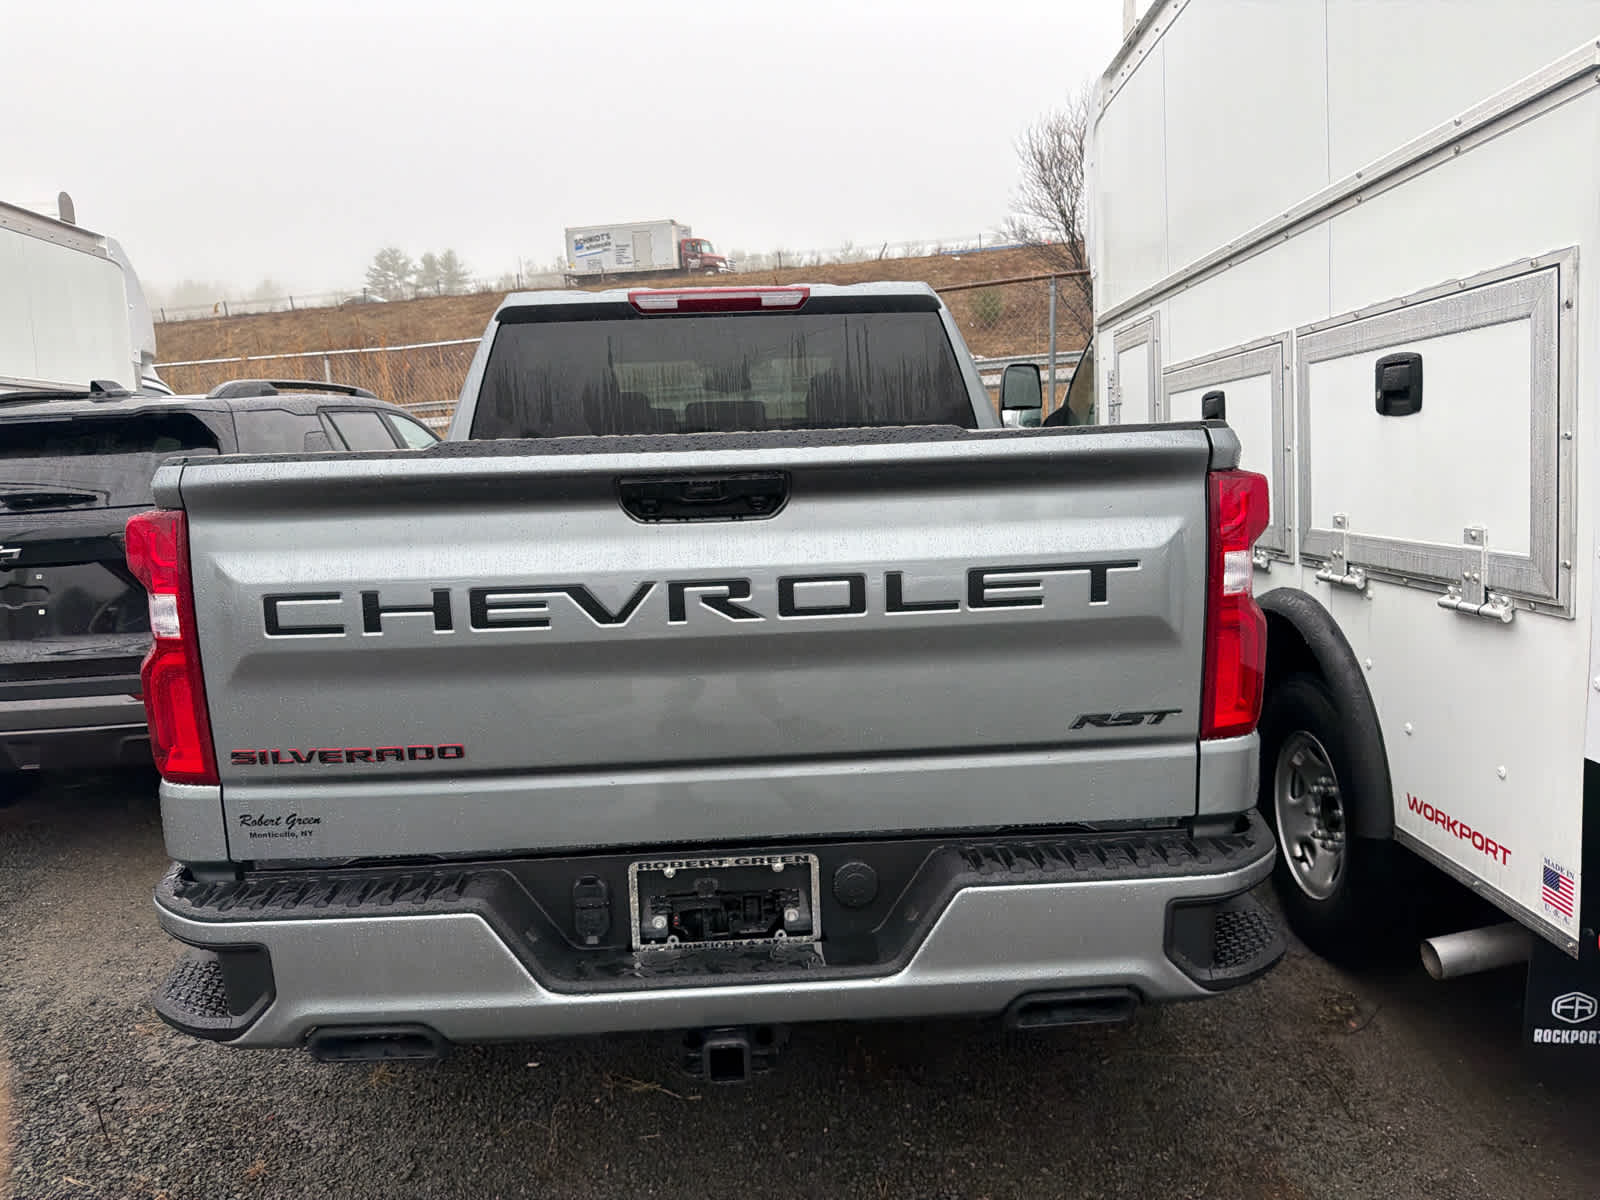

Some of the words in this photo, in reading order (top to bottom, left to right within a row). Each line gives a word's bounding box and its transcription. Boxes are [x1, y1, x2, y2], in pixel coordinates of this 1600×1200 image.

[263, 559, 1141, 639] CHEVROLET
[1069, 708, 1183, 730] RST
[230, 744, 465, 765] SILVERADO
[239, 814, 282, 827] Robert
[285, 813, 321, 830] Green
[1406, 791, 1512, 866] WORKPORT
[638, 861, 729, 870] ROBERT
[734, 855, 809, 865] GREEN
[1543, 856, 1564, 873] MADE
[1566, 869, 1575, 880] IN
